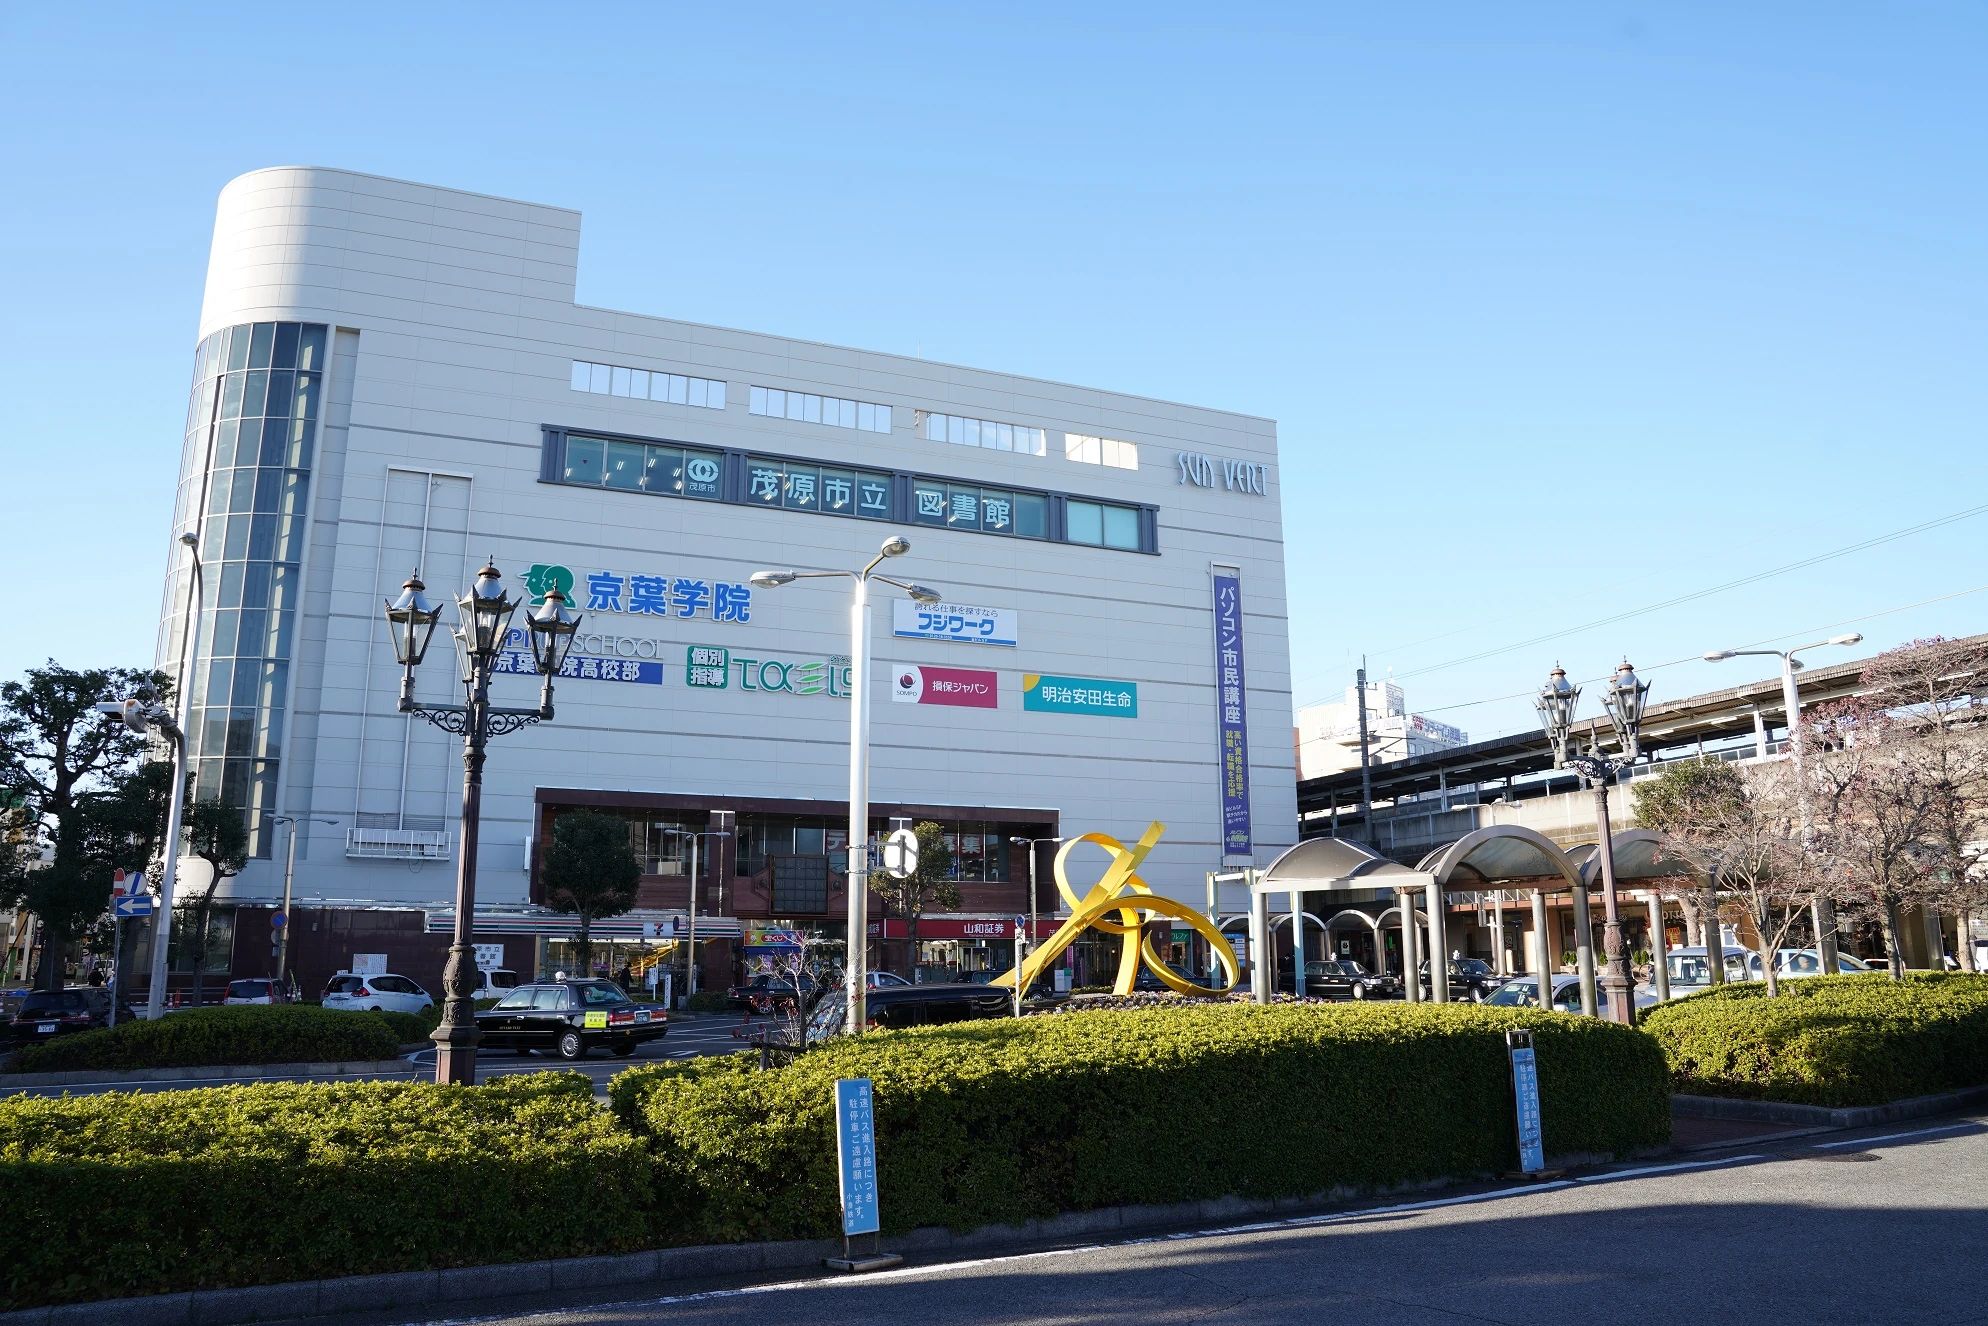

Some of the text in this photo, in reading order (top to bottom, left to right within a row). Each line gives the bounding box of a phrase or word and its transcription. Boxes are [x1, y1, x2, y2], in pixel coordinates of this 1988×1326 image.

[1178, 451, 1268, 497] SUN VERT
[750, 468, 1010, 526] 茂原市立 図書館
[585, 570, 752, 624] 京葉学院
[918, 612, 995, 636] フジワーク
[572, 631, 664, 660] SCHOOL
[691, 647, 725, 667] 個別
[1220, 586, 1242, 725] パソコン市民講座
[496, 650, 641, 682] 京葉院高校部
[690, 667, 725, 687] 指導
[896, 690, 918, 698] SOMPO
[932, 680, 989, 695] 損保ジャパン
[1042, 686, 1132, 708] 明治安田生命
[963, 923, 1005, 934] 山和証券
[849, 1098, 864, 1219] 駐停車ご遠慮願います。
[858, 1086, 873, 1203] 高速バス進入路につき
